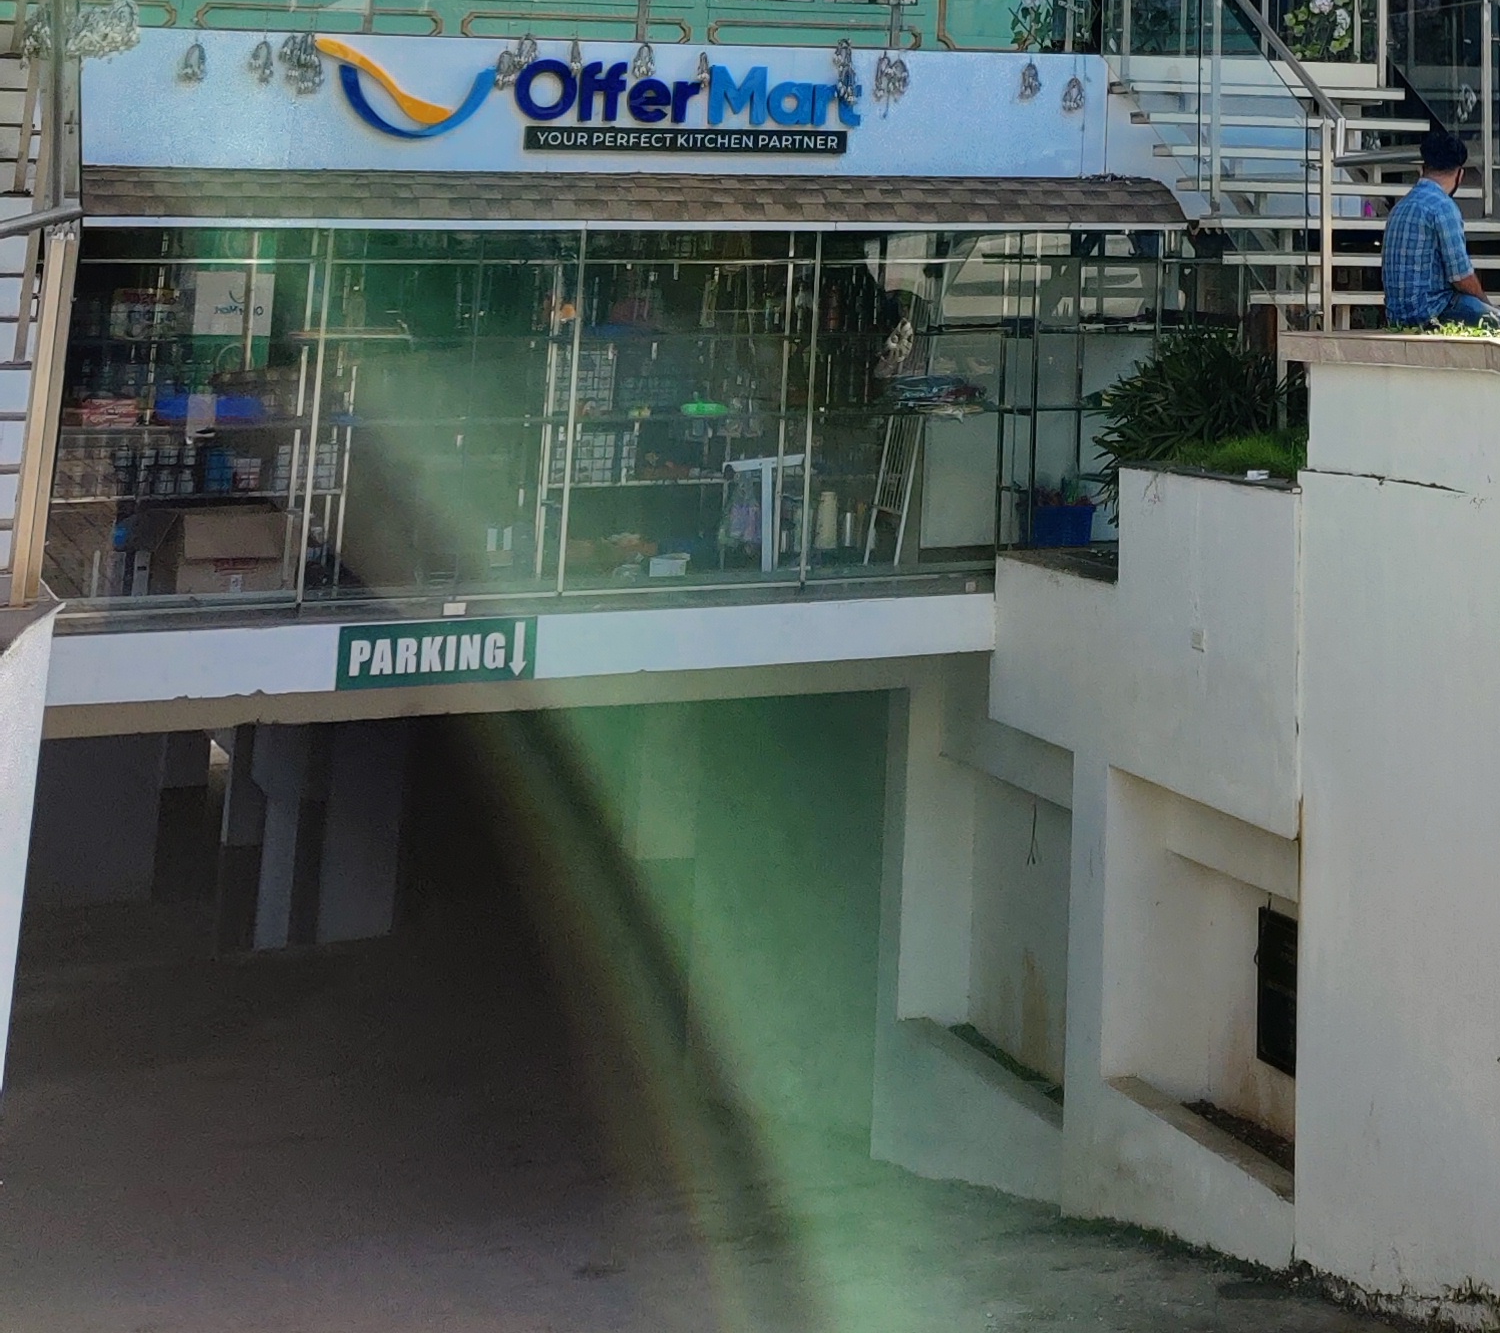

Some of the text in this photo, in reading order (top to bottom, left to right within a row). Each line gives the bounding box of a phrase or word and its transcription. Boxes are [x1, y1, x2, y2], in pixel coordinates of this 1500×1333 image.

[537, 131, 839, 150] YOUR PERFECT KITCHEN PARTNER
[348, 632, 506, 677] PARKING
